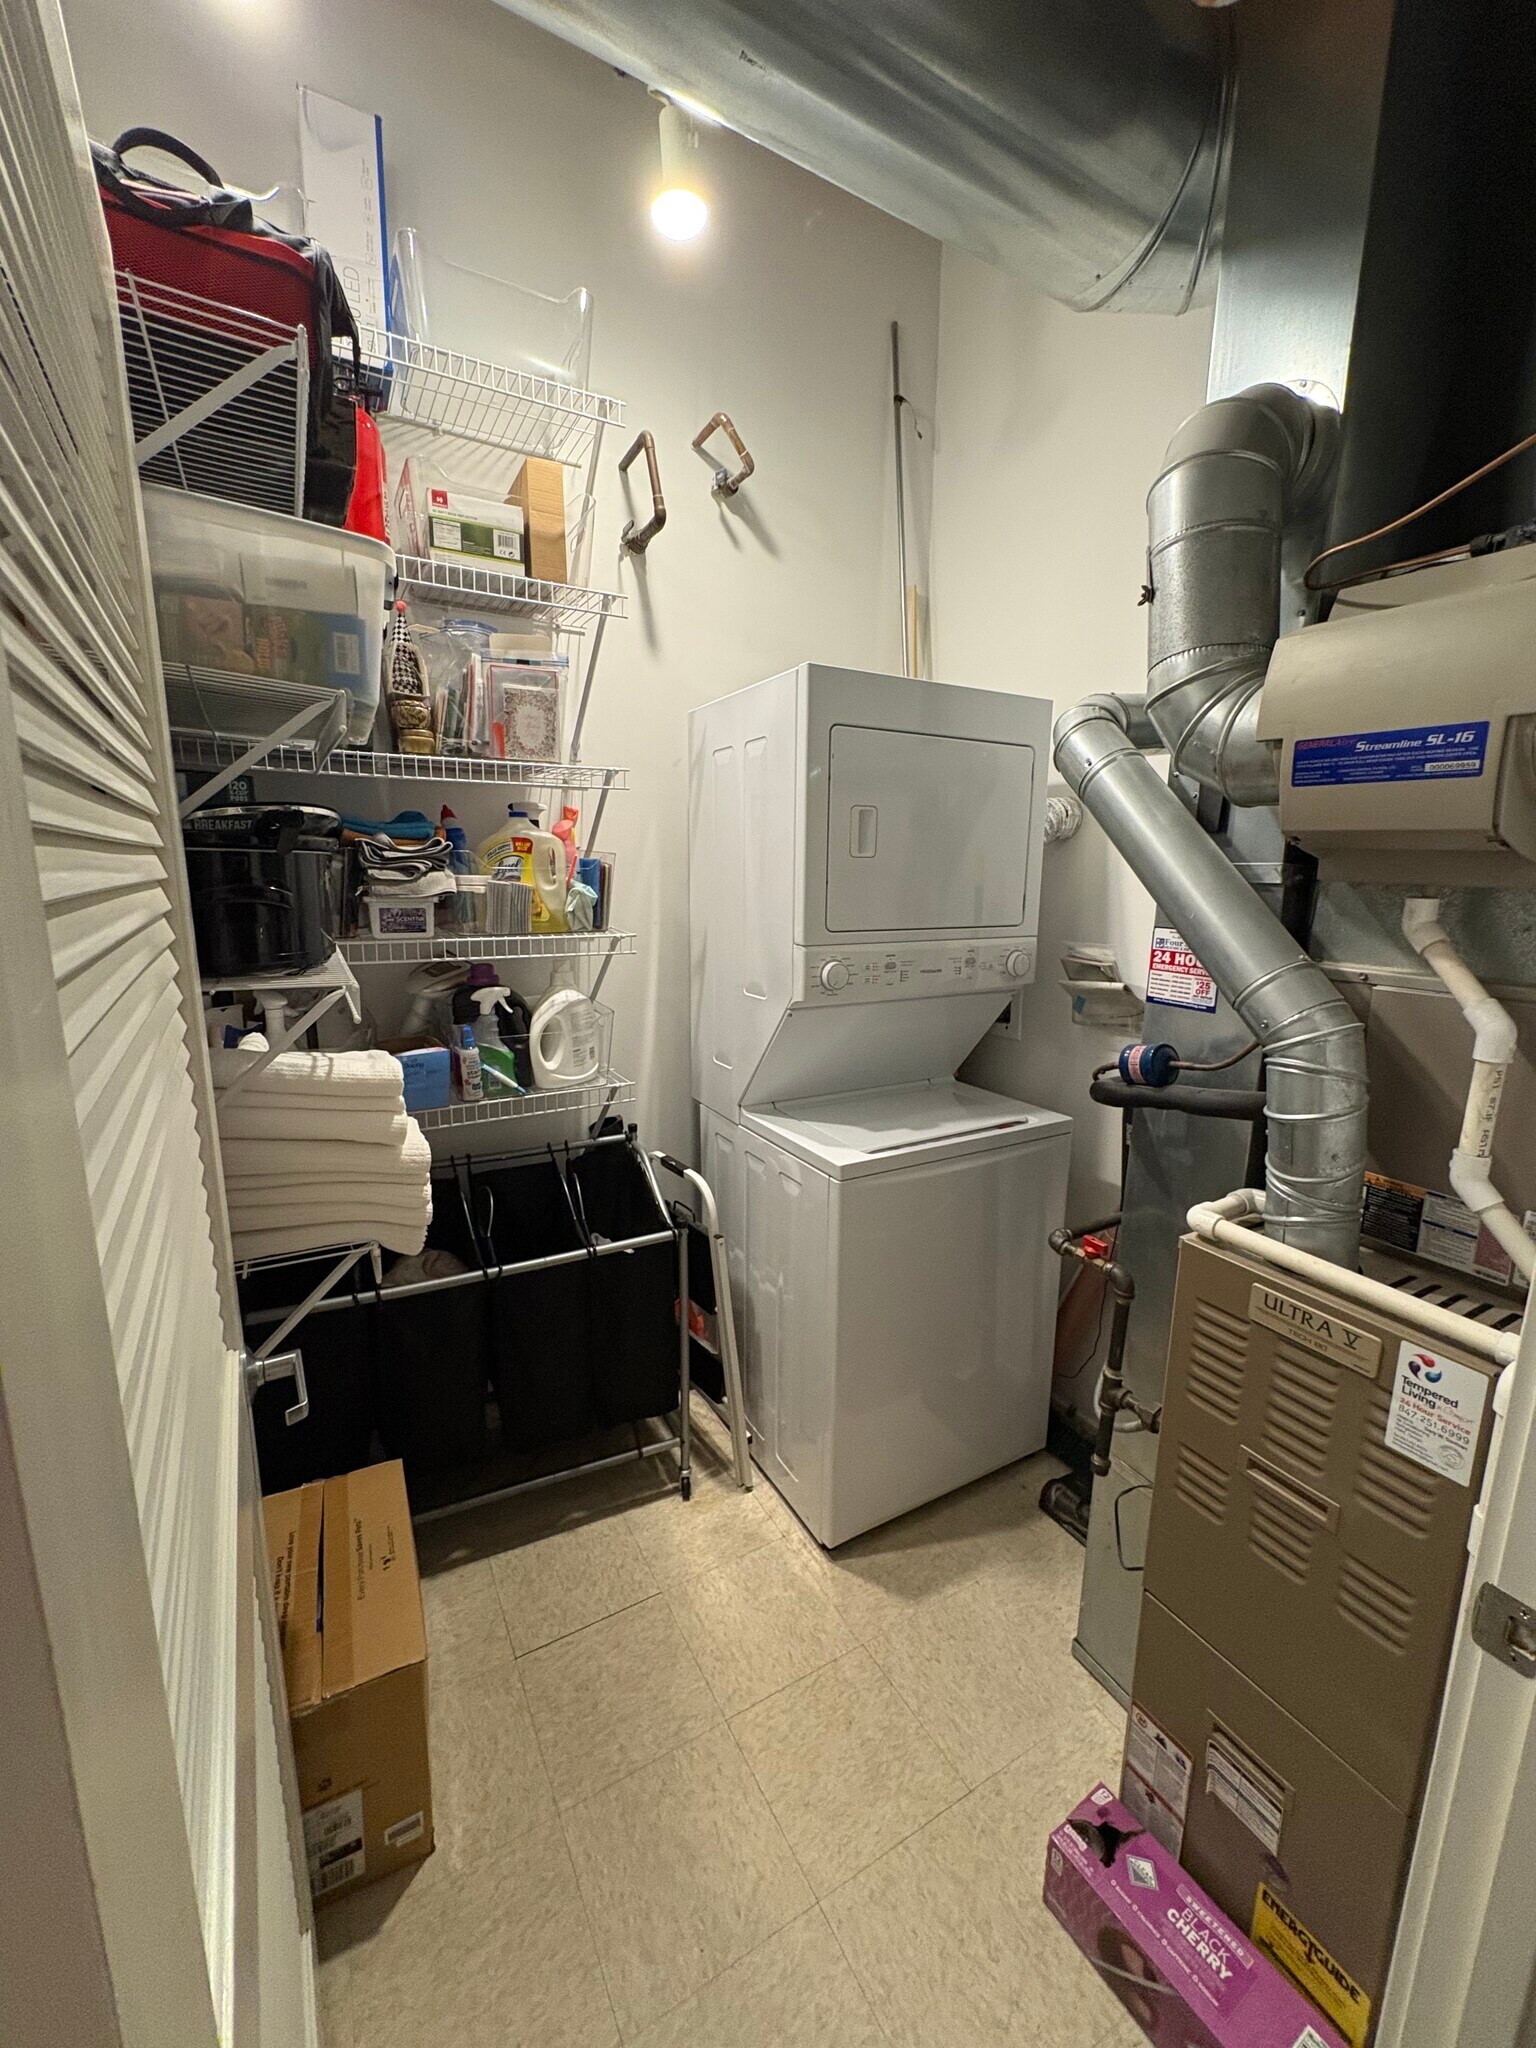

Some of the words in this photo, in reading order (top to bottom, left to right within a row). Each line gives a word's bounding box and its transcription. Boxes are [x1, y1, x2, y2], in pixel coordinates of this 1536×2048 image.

[1355, 740, 1422, 752] Streamline
[1425, 731, 1476, 746] SL-16
[194, 819, 252, 831] BREAKFAST
[1152, 963, 1189, 973] EMERGENCY
[1153, 951, 1171, 963] 24
[1195, 988, 1211, 996] OFF
[1264, 1293, 1333, 1339] ULTRA
[1342, 1328, 1362, 1350] V
[1402, 1375, 1458, 1408] Tempered
[1402, 1385, 1436, 1409] Living
[1412, 1402, 1434, 1417] Hour
[1436, 1412, 1471, 1435] Service
[1182, 1907, 1231, 1964] BLACK
[1185, 1896, 1244, 1957] SWEETENED
[1167, 1908, 1234, 1979] CHERRY
